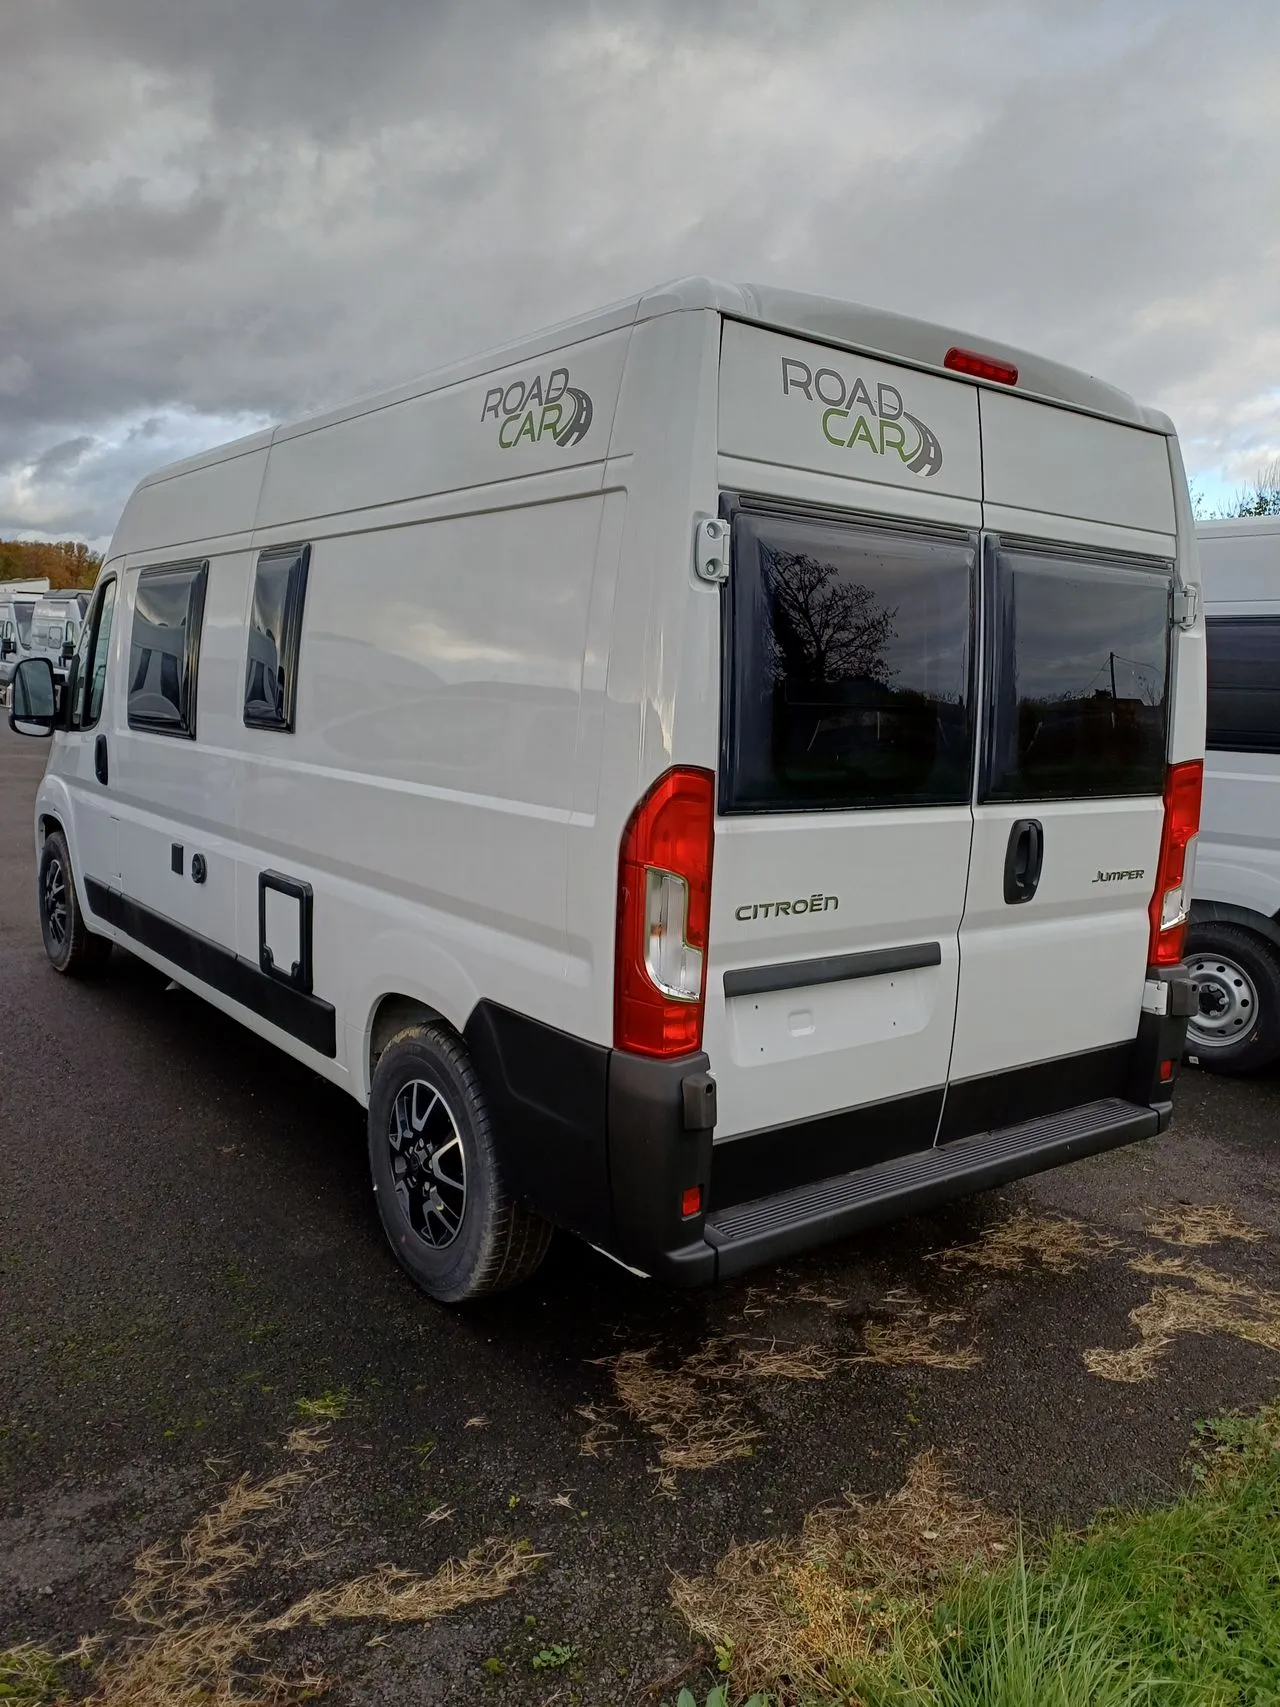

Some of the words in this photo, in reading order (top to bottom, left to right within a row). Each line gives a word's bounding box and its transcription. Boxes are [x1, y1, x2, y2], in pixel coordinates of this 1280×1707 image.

[481, 368, 569, 422] ROAD
[783, 357, 903, 421] ROAD
[499, 403, 570, 448] CAR
[822, 407, 915, 462] CAR
